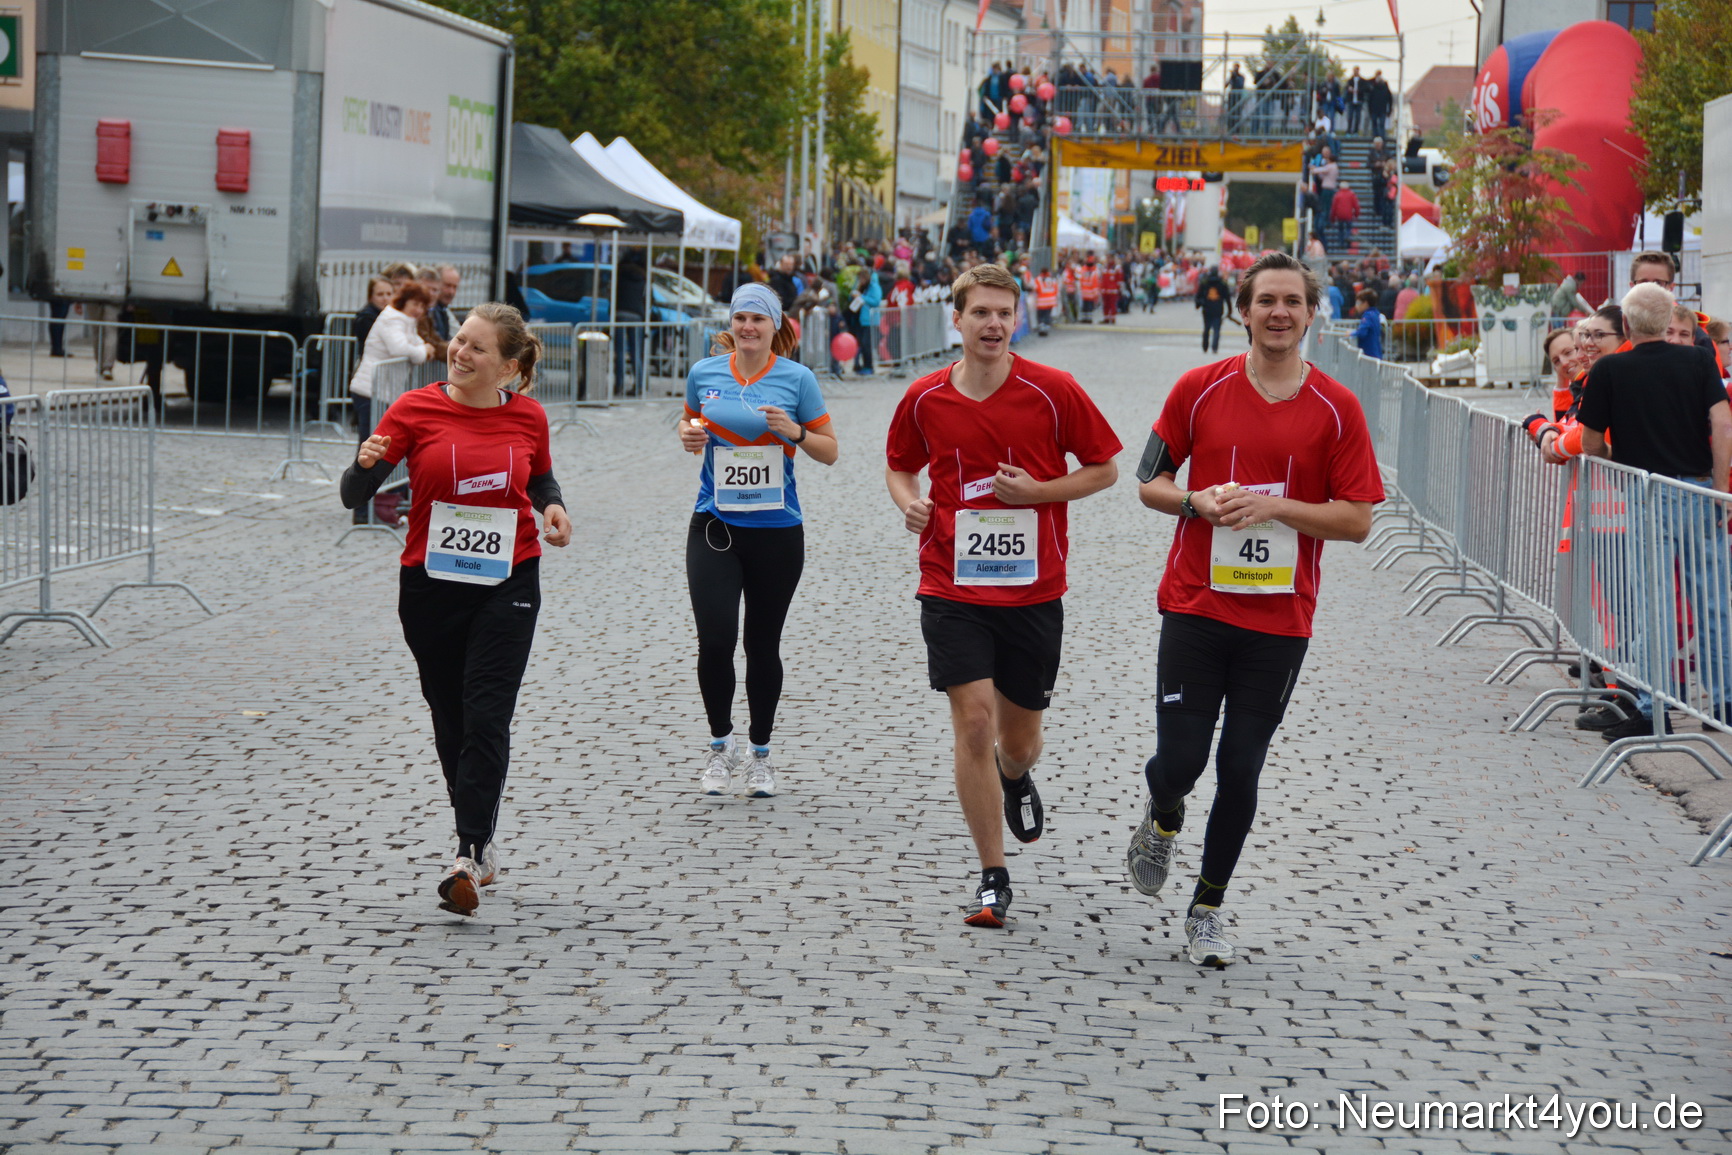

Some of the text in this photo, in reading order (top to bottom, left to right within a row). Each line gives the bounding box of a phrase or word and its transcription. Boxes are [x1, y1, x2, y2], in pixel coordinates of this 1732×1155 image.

[342, 95, 432, 145] OFFICE INDUSTRY LOUNGE
[447, 99, 494, 177] BOCK
[1155, 146, 1208, 166] ZIEL
[724, 465, 770, 486] 2501
[471, 478, 494, 489] DEHN
[976, 482, 994, 492] DEH
[736, 491, 762, 500] Jasmin
[463, 511, 492, 521] BOCK
[987, 516, 1015, 524] BOCK
[440, 526, 502, 555] 2328
[967, 533, 1025, 556] 2455
[1238, 538, 1270, 563] 45
[454, 559, 482, 571] Nicole
[976, 563, 1018, 572] Alexander
[1233, 570, 1273, 582] Christoph
